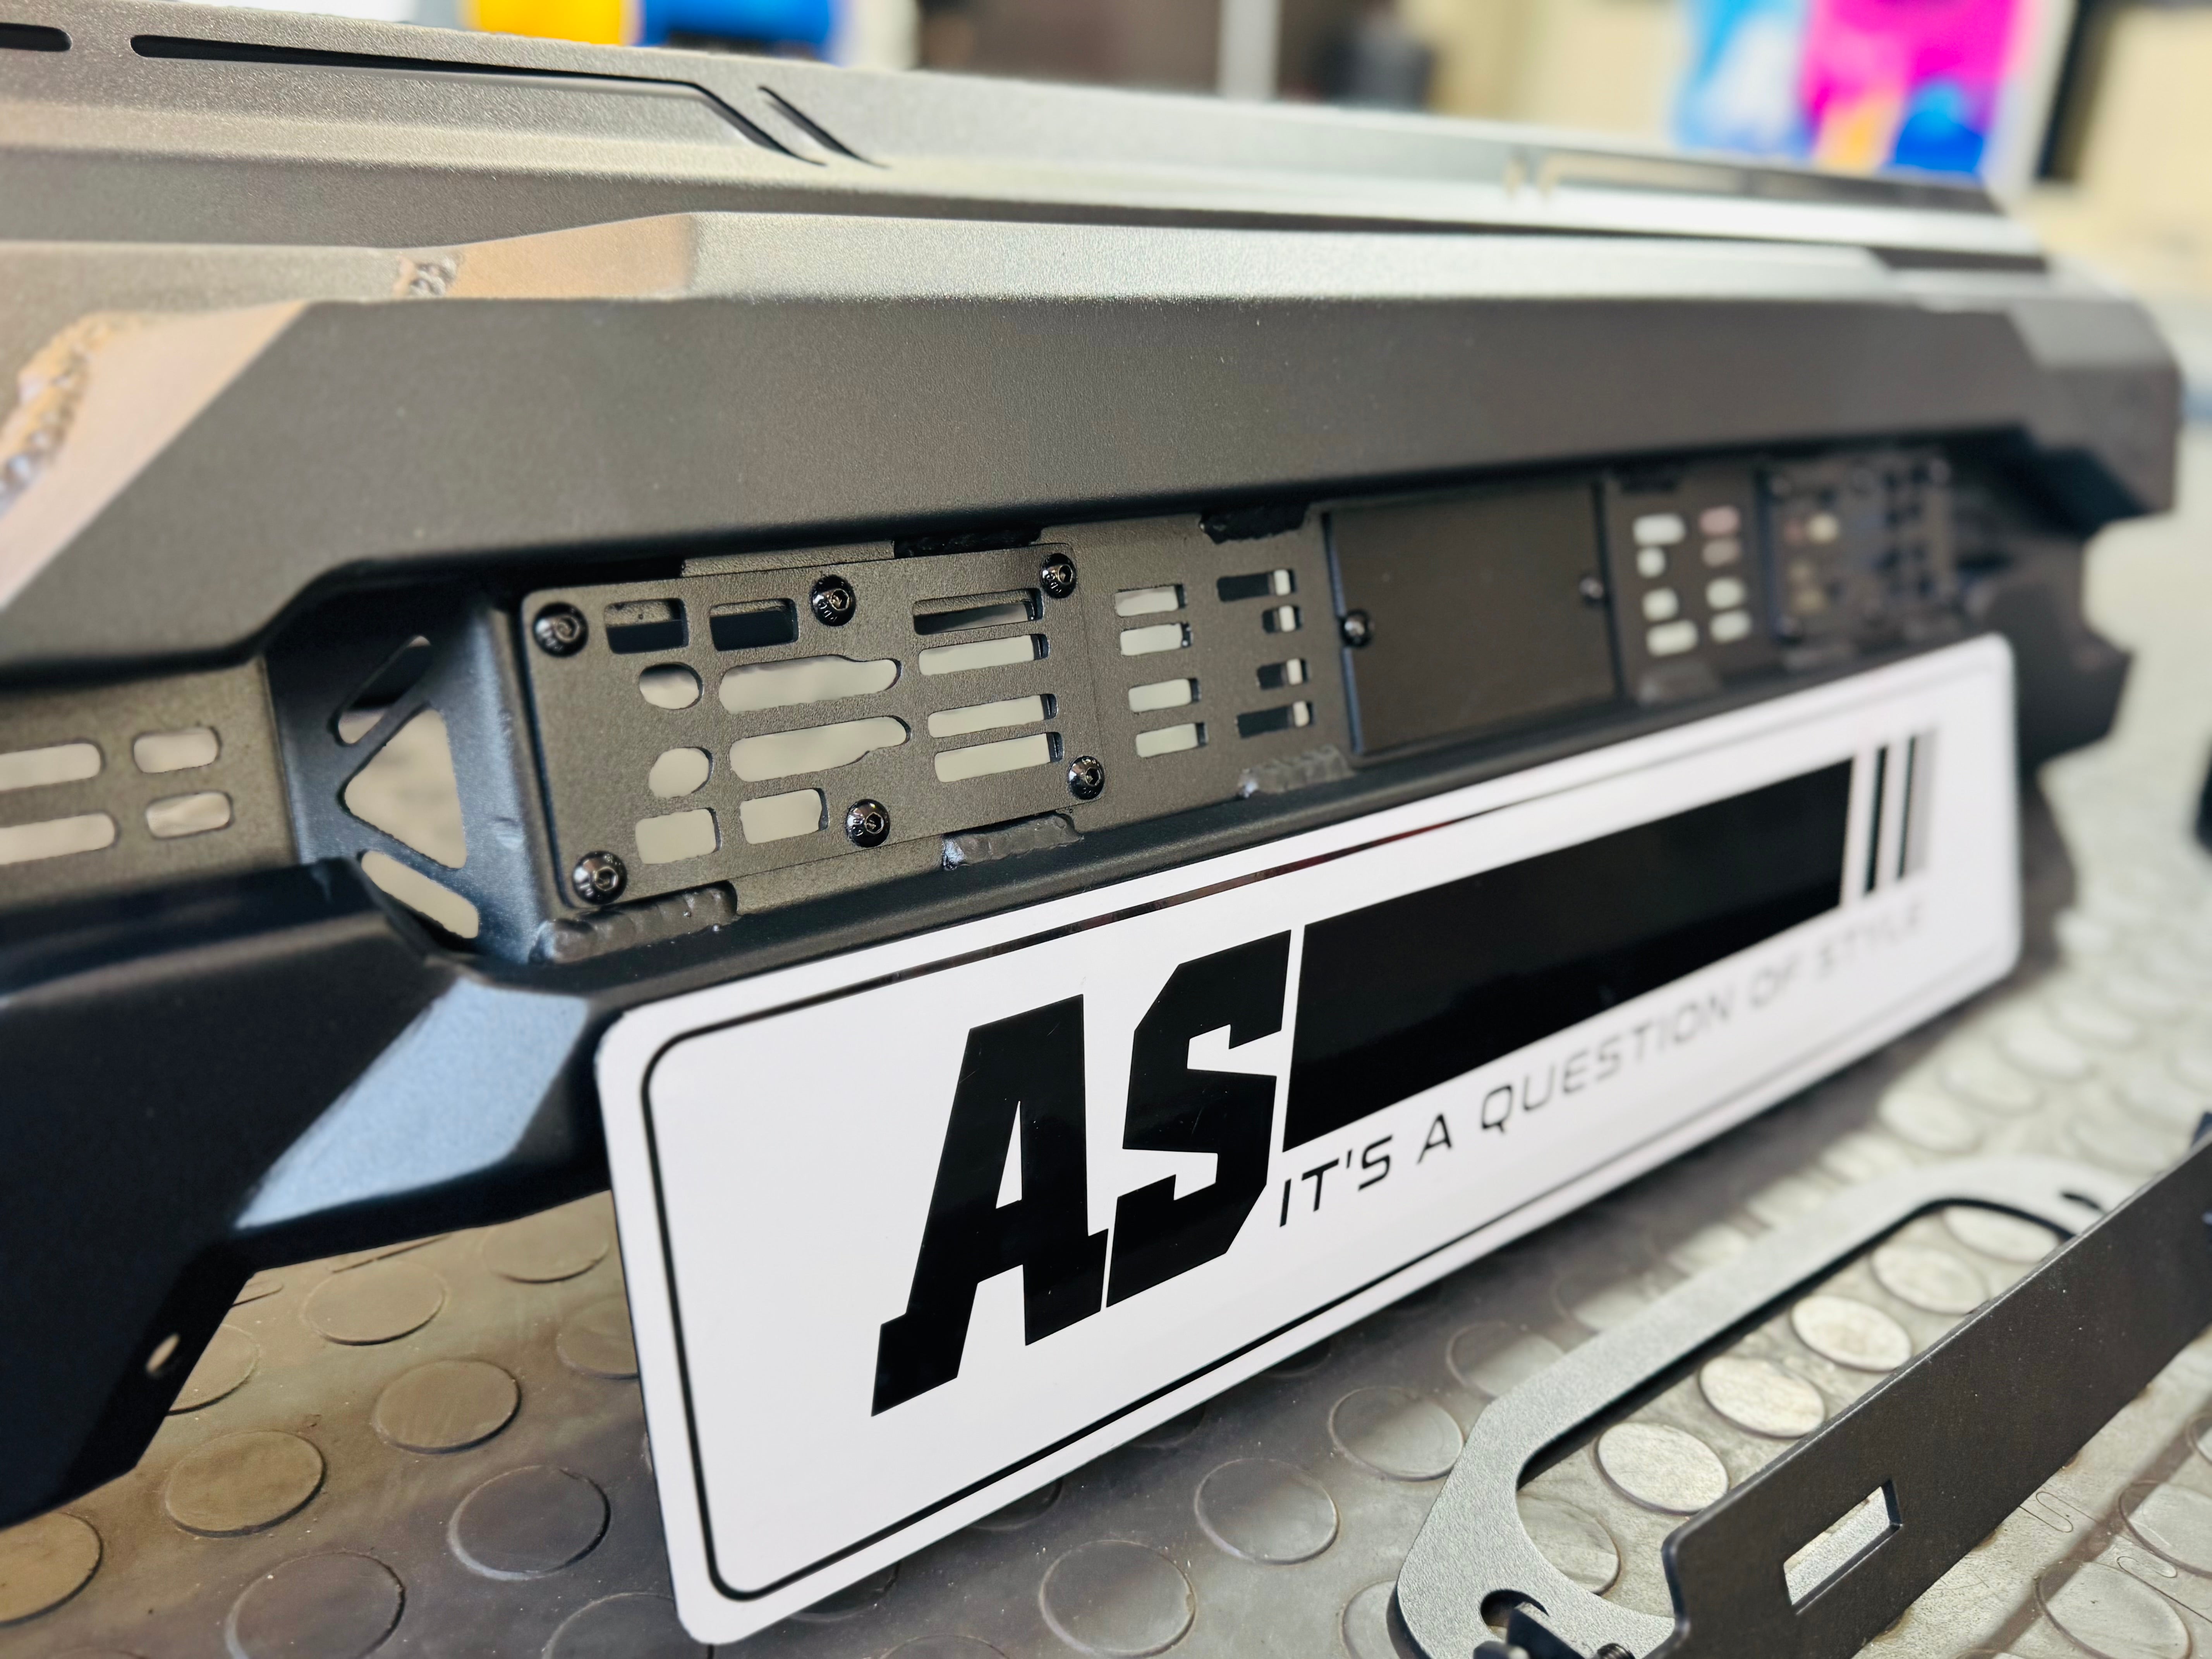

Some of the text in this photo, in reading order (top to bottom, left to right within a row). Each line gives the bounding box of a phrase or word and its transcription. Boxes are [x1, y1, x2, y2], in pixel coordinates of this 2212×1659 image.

[871, 929, 1291, 1416] AS
[1279, 898, 1925, 1227] IT'S A QUESTION OF STYLE
